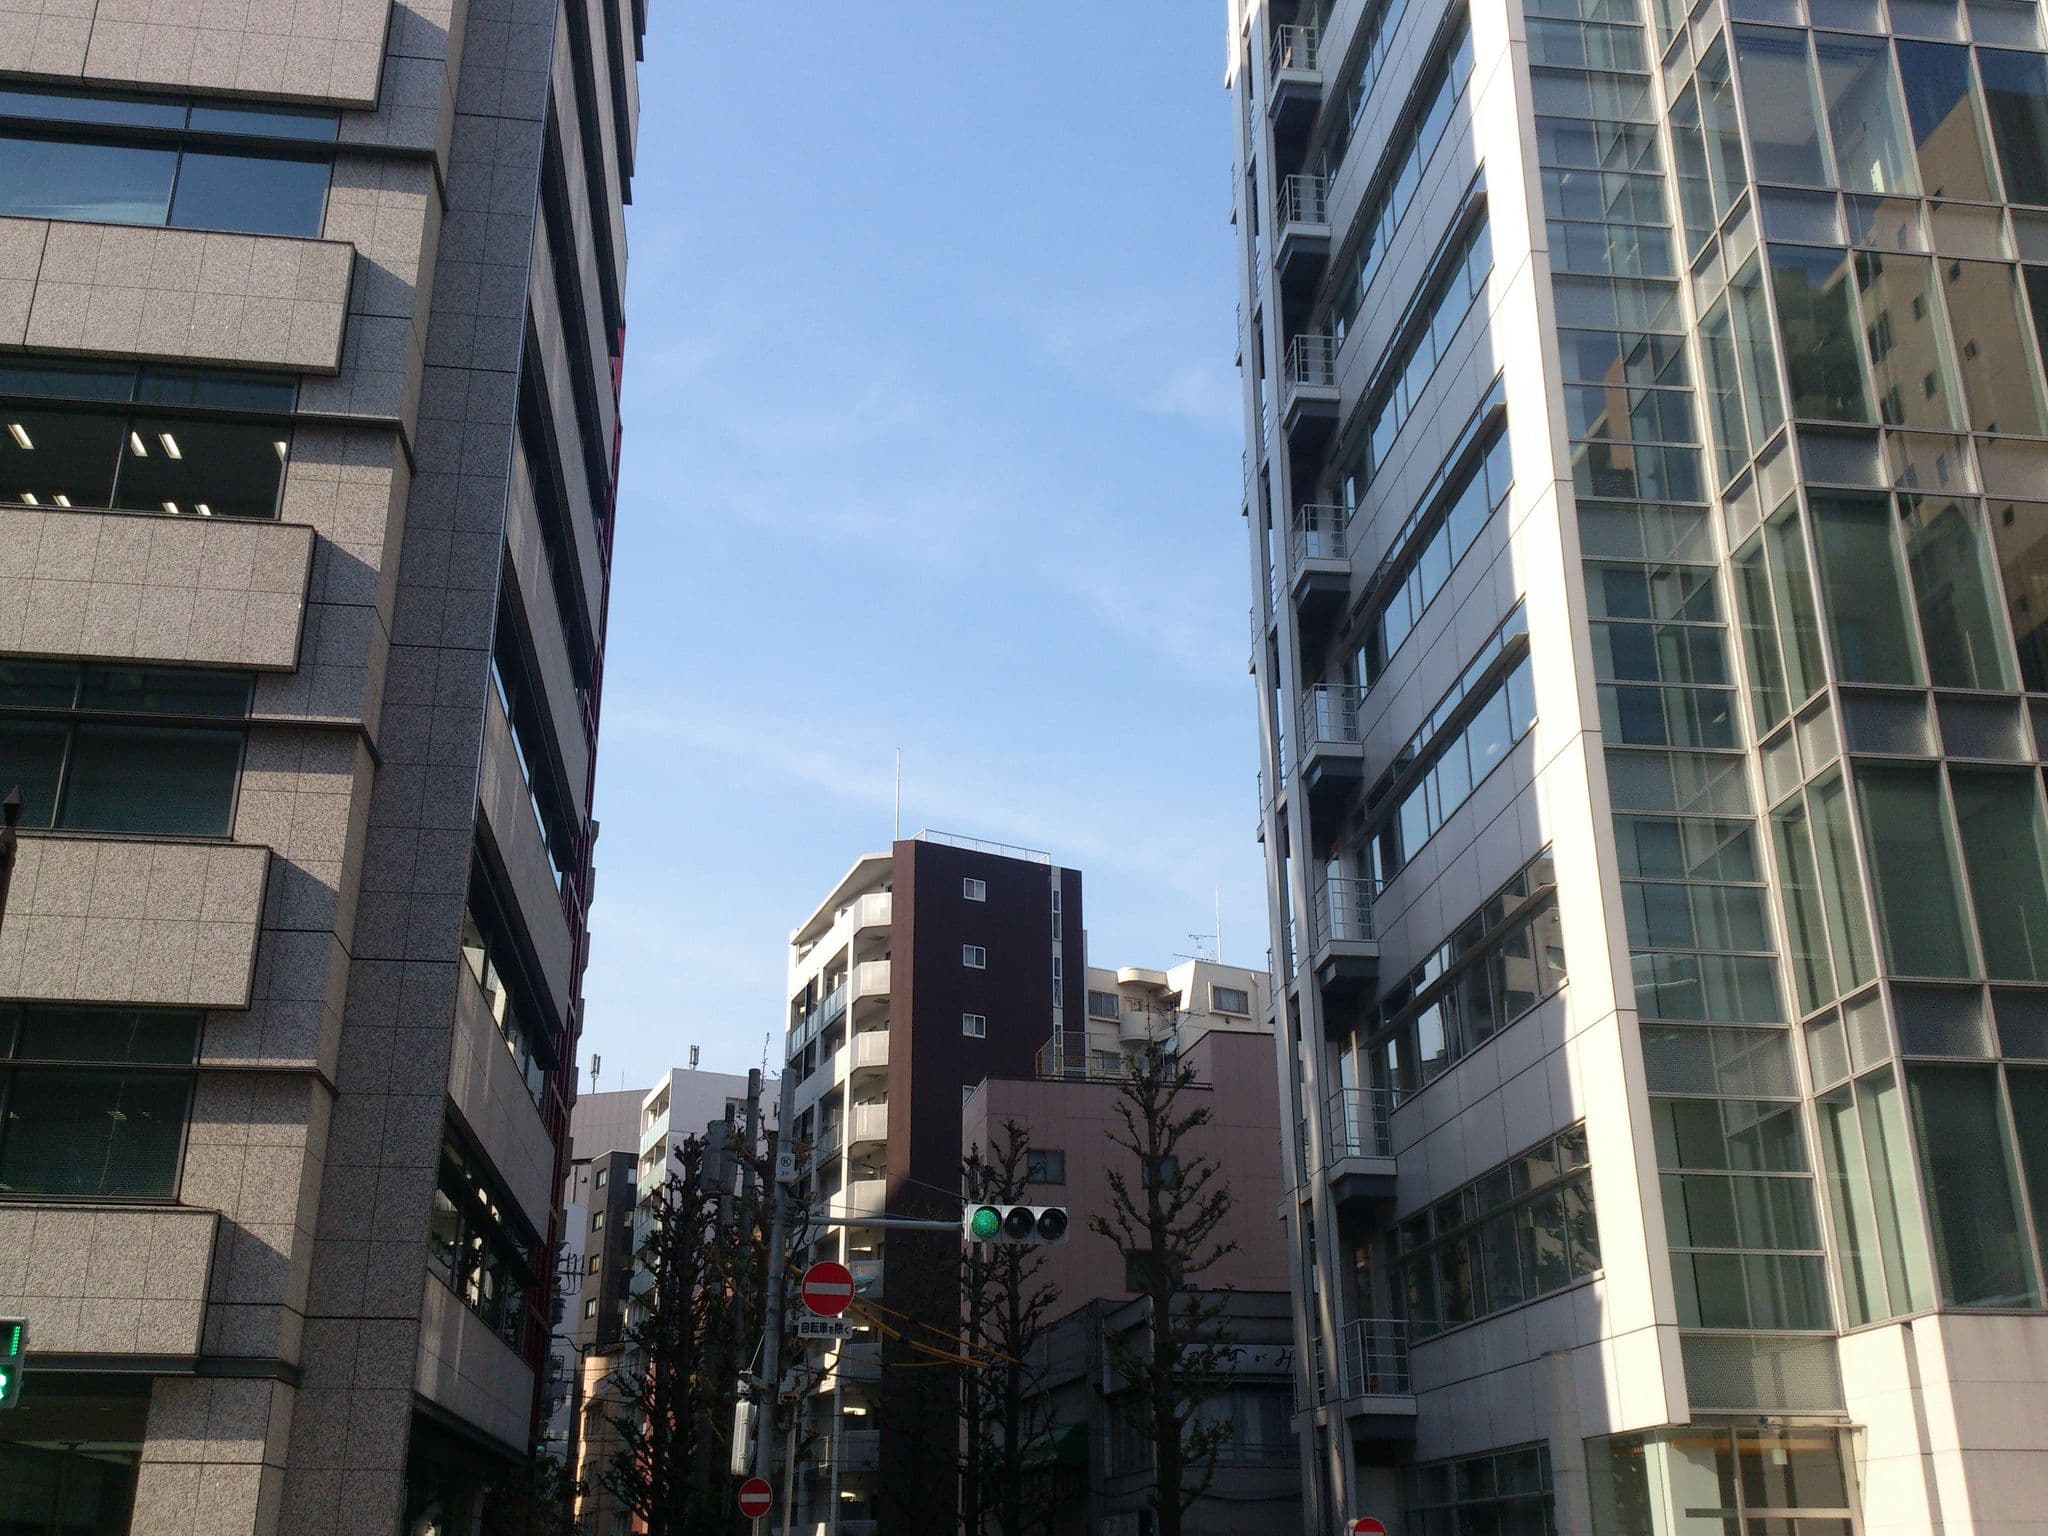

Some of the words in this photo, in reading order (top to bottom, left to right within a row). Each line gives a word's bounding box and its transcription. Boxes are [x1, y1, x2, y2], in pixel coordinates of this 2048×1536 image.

[801, 1322, 849, 1335] 自転車を除く
